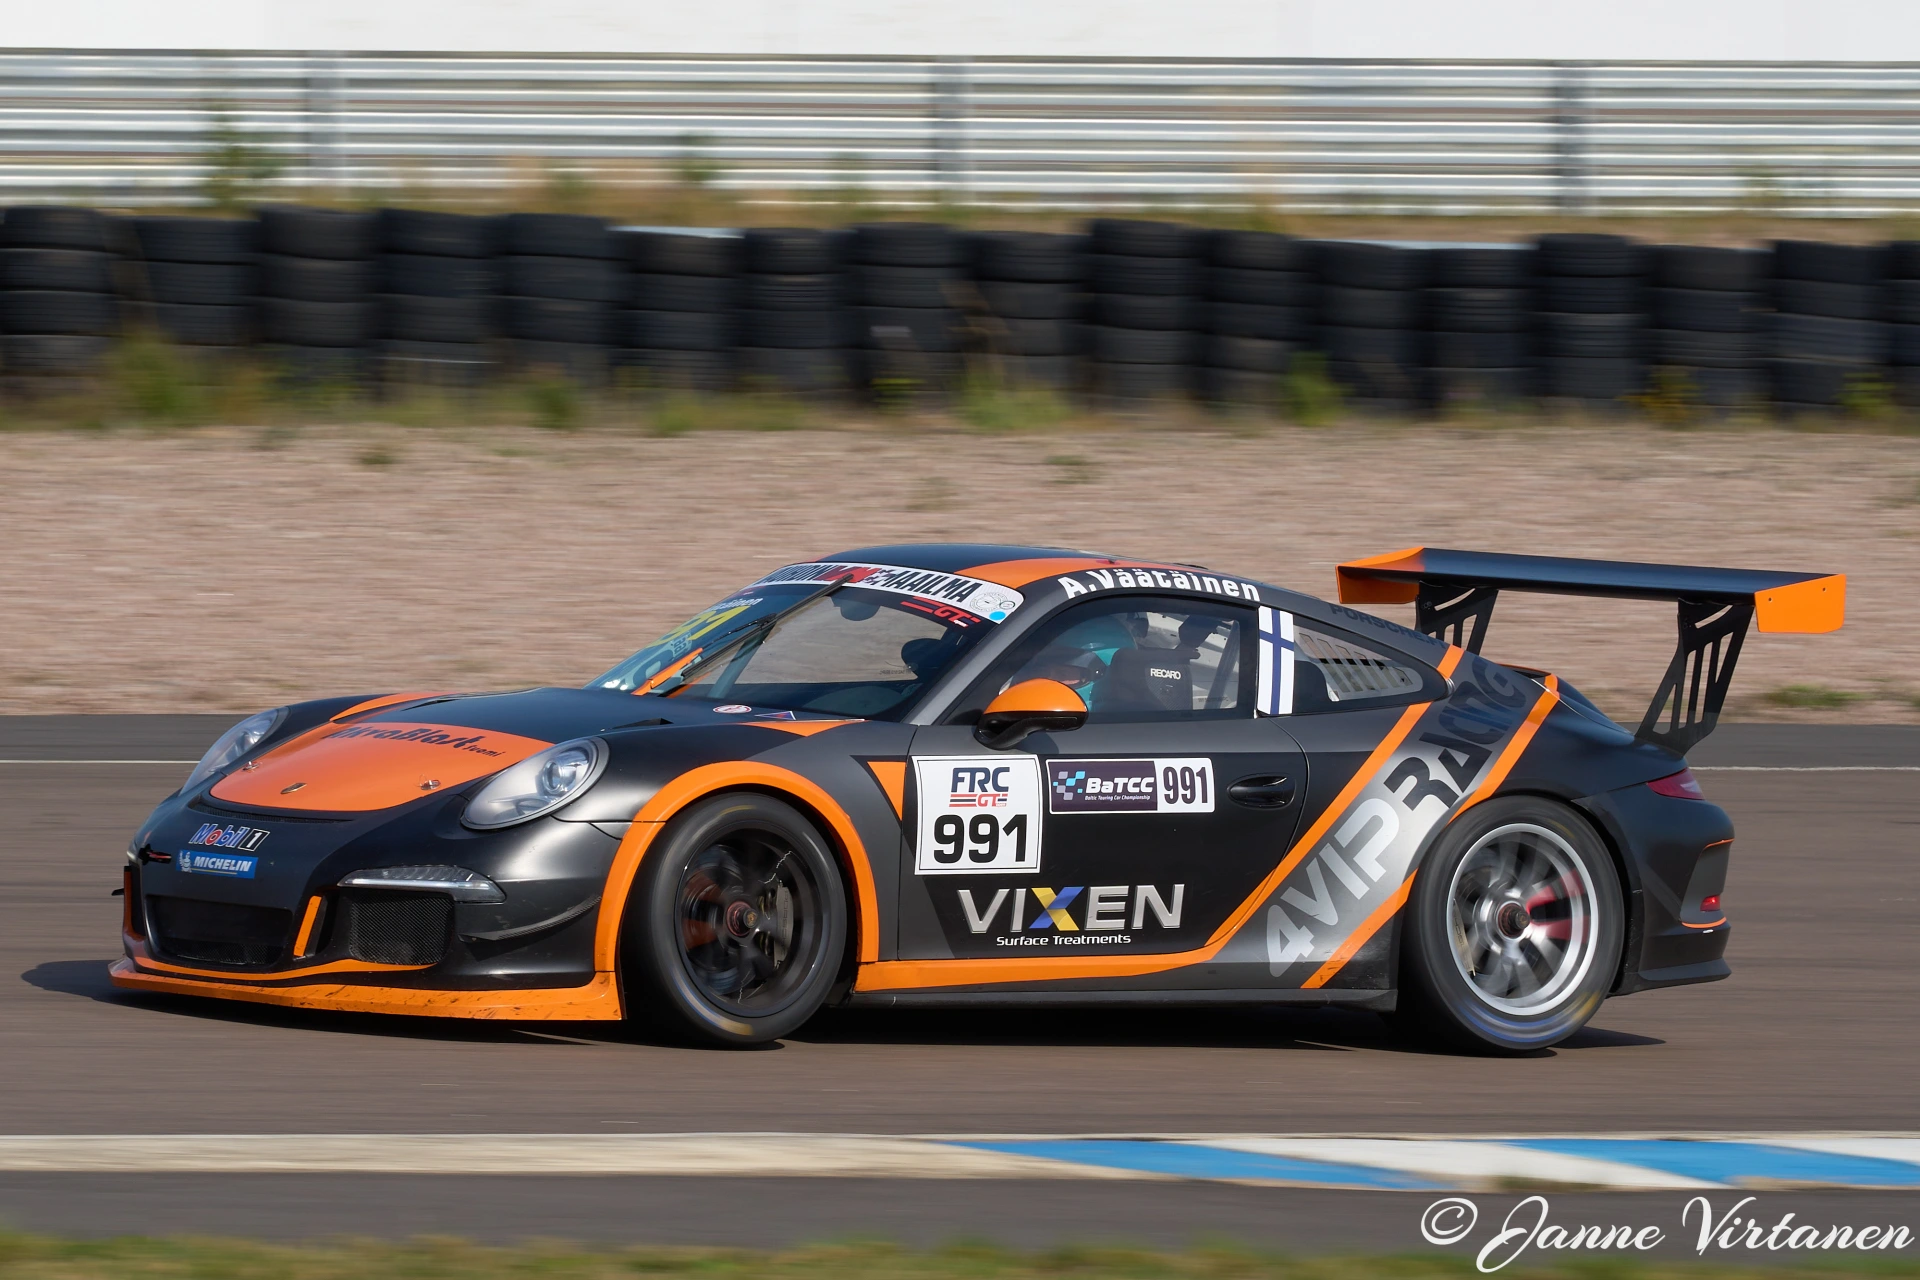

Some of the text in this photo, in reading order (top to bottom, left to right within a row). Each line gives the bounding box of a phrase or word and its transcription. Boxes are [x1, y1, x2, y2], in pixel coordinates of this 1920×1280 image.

[1057, 567, 1260, 602] A.Väätäinen
[1150, 667, 1182, 680] RECARO
[951, 766, 1010, 793] FRC
[1085, 776, 1155, 794] BaTCC
[1162, 766, 1208, 805] 991
[1266, 656, 1528, 977] 4VIP RACING
[188, 823, 250, 849] Mobil
[933, 814, 1028, 864] 991
[193, 856, 253, 872] MICHELIN
[957, 883, 1185, 934] VIXEN
[996, 934, 1131, 947] Surface Treatments
